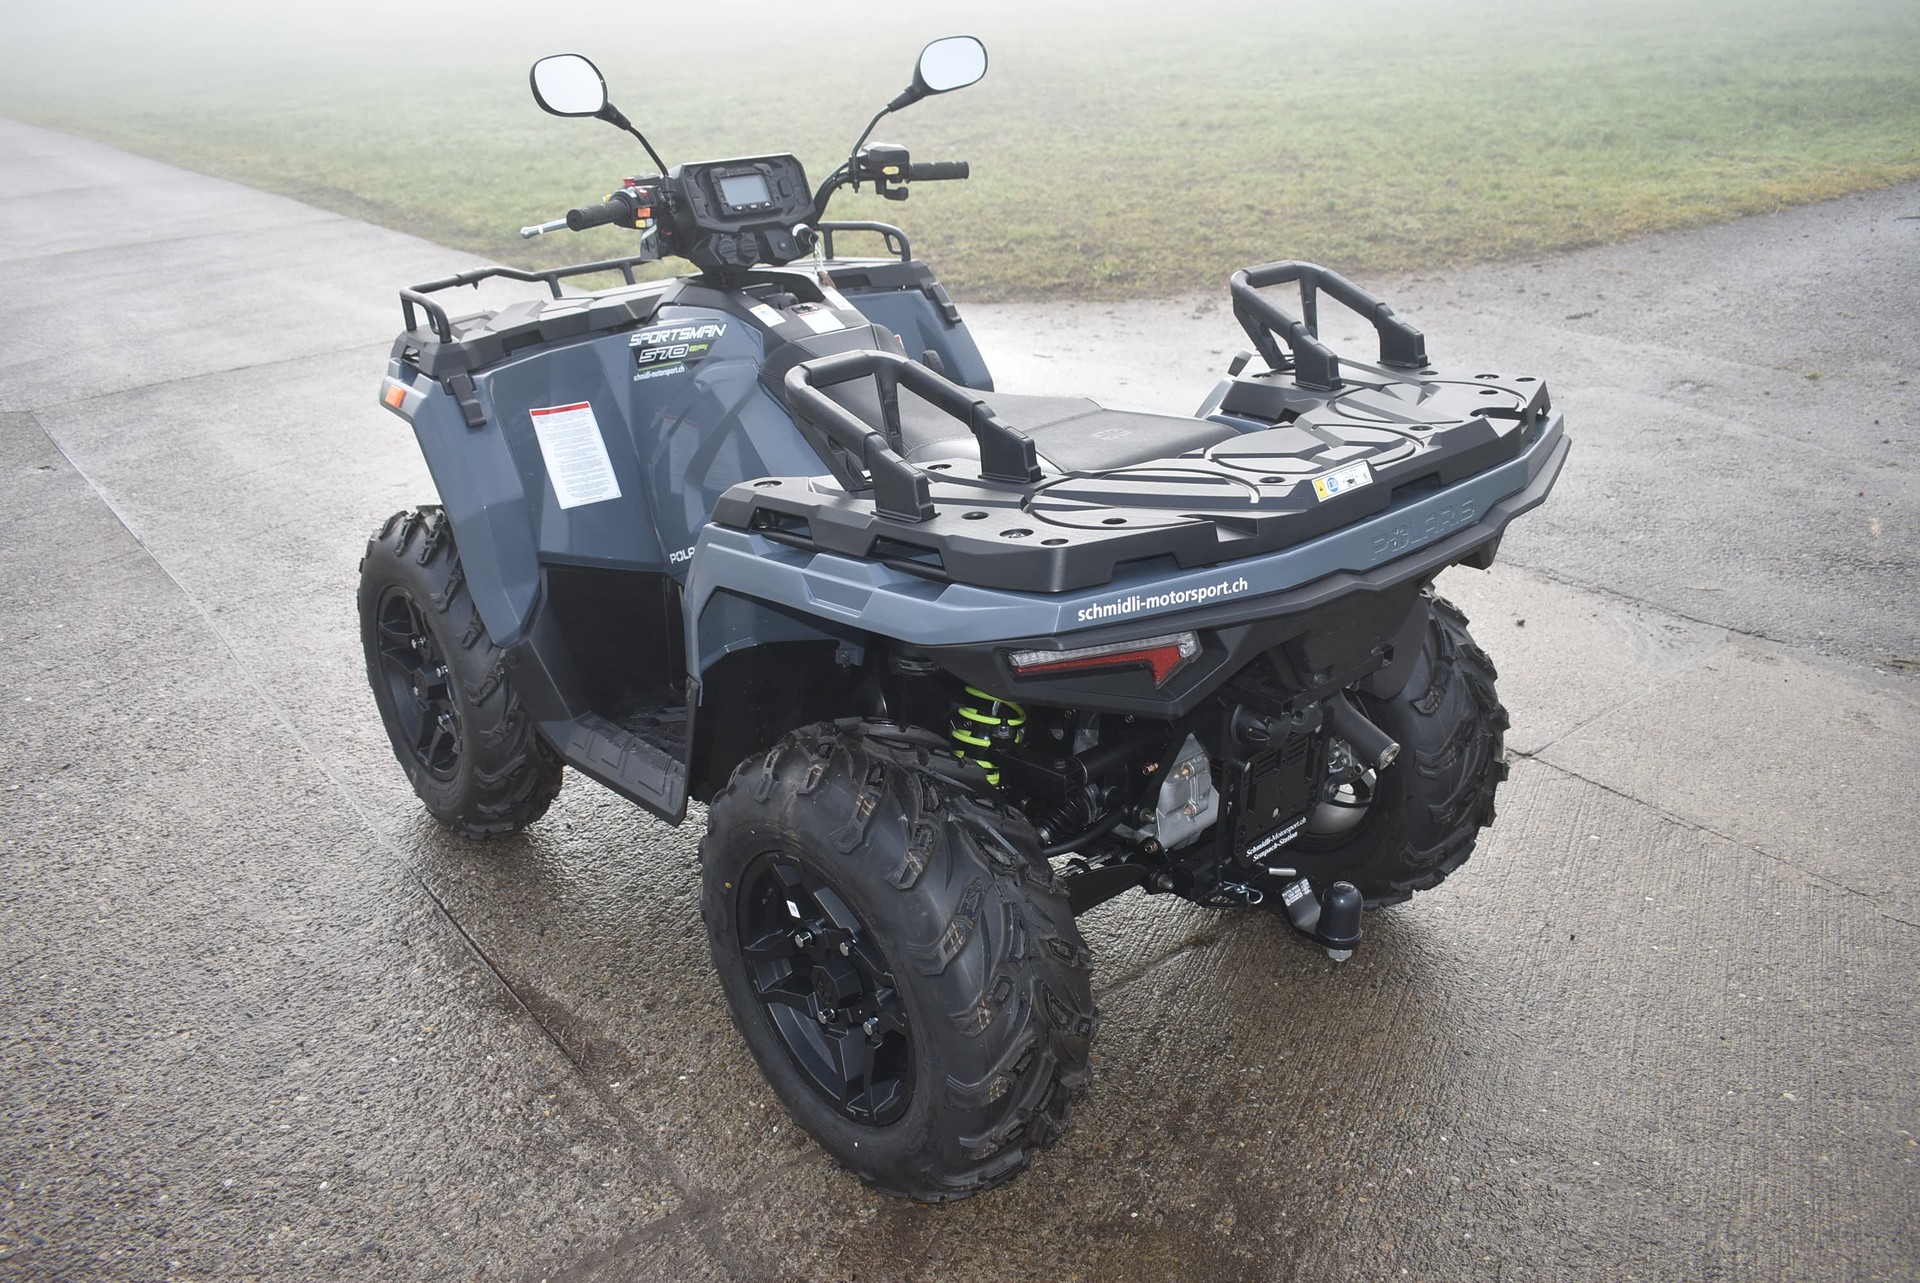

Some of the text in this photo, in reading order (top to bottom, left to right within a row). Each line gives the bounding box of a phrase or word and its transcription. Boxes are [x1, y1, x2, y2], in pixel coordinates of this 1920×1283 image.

[628, 324, 727, 347] SPORTSMAN
[639, 343, 689, 363] 570
[1369, 498, 1475, 561] POLARIS
[669, 545, 697, 564] POLA
[1077, 577, 1248, 621] schmidli-motorsport.ch
